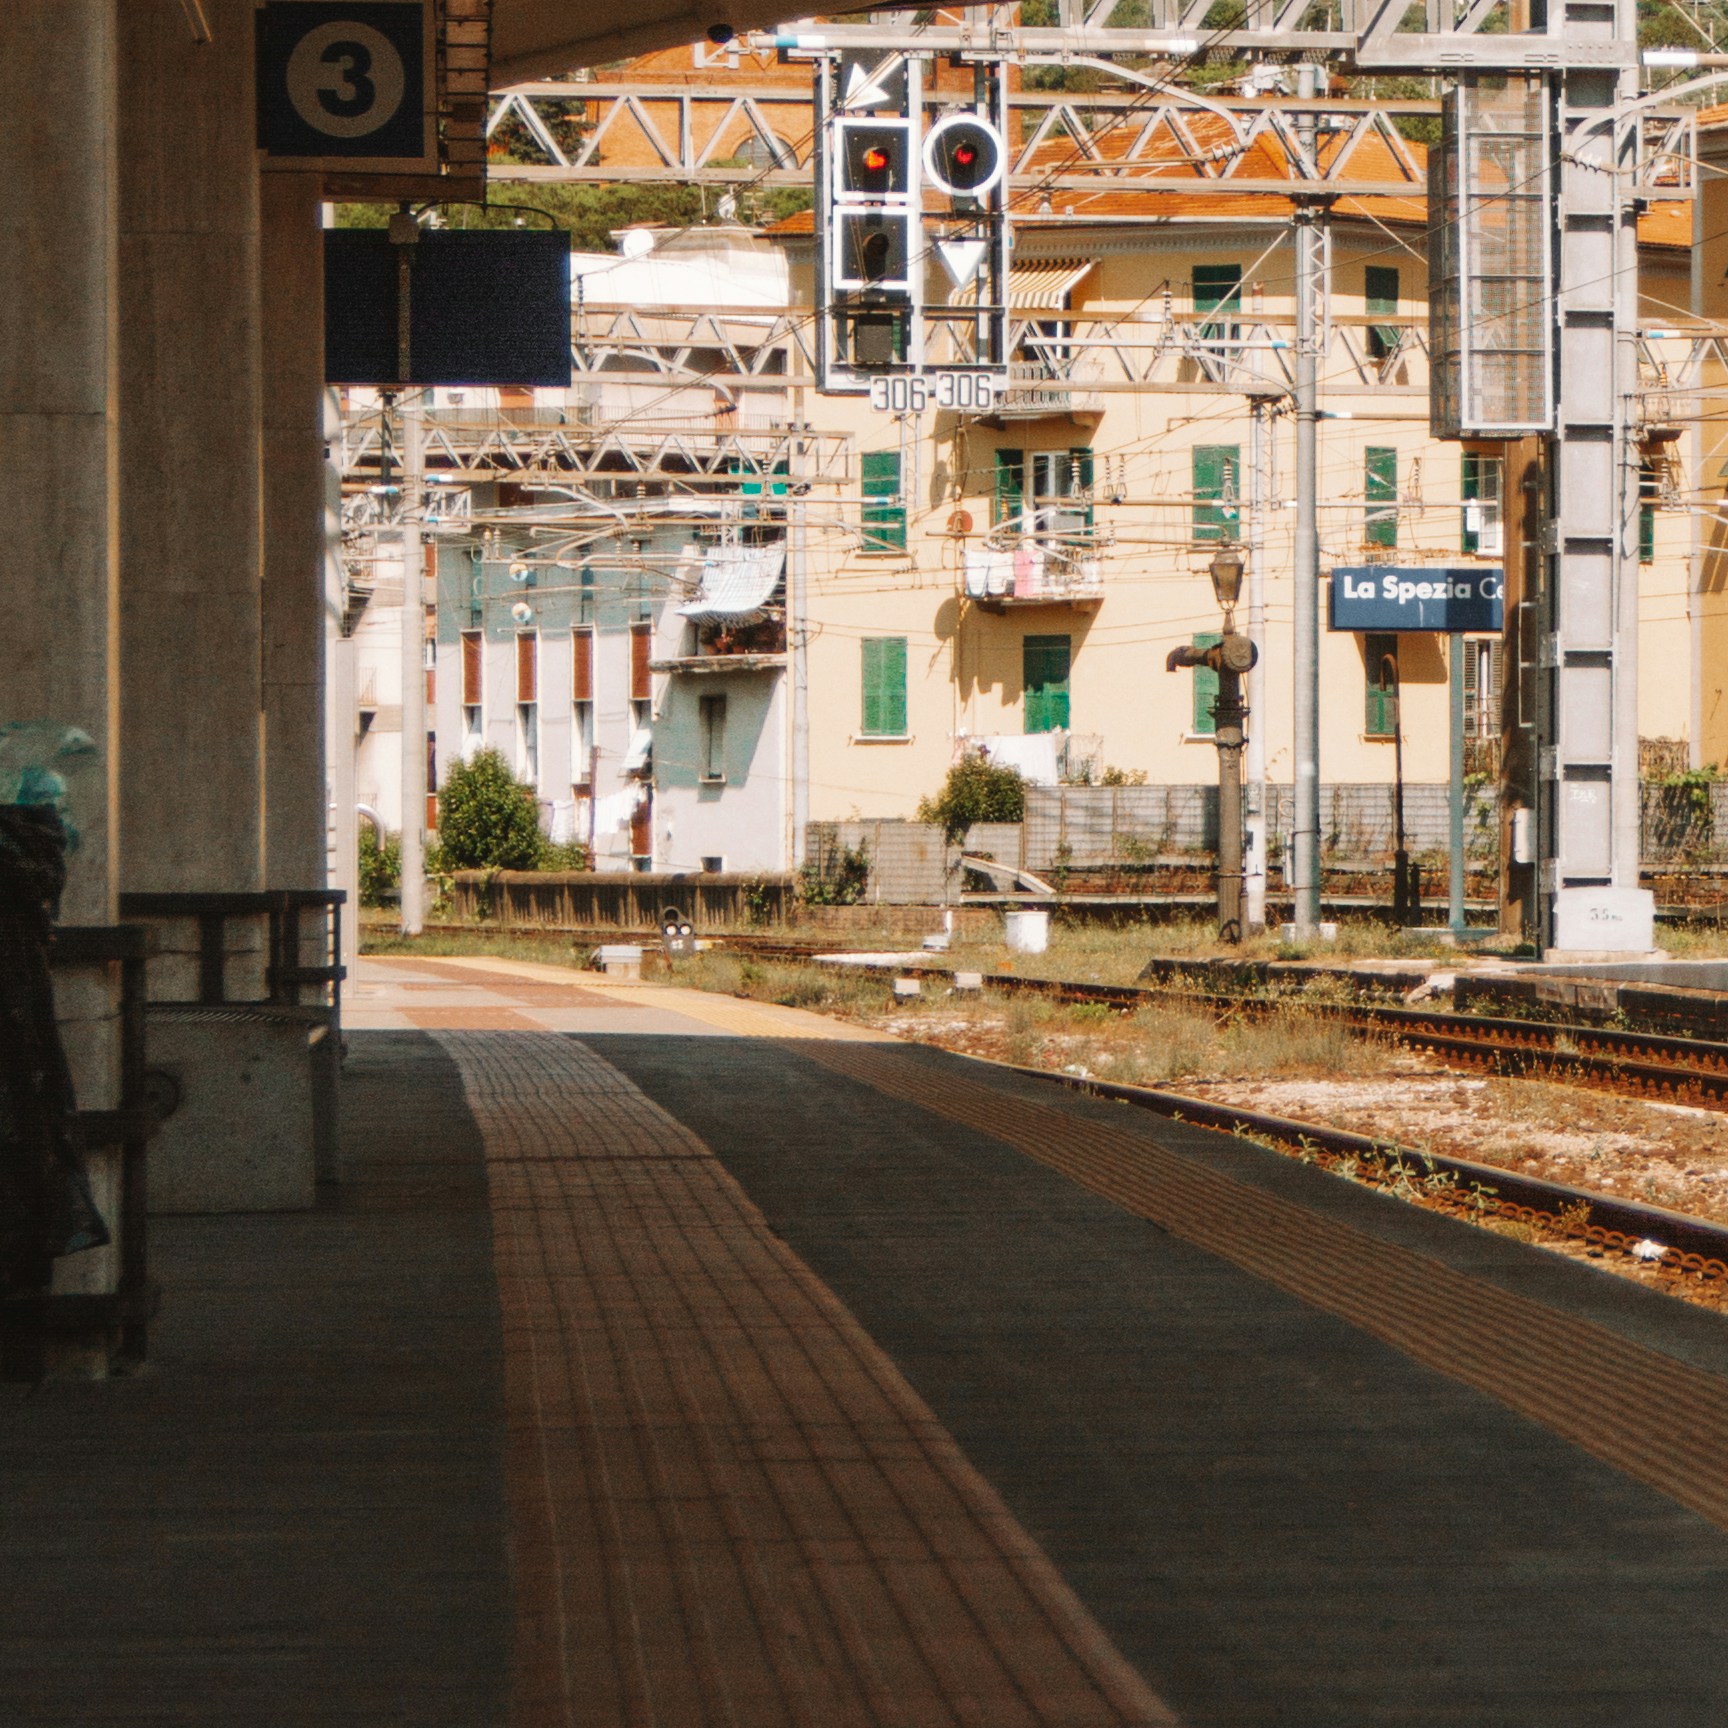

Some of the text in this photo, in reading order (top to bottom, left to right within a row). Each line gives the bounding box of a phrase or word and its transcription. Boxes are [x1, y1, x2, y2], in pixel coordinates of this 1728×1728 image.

[317, 40, 377, 118] 3
[873, 377, 926, 411] 306
[938, 373, 991, 408] 306
[1343, 575, 1376, 599] La
[1382, 575, 1472, 604] Spezia
